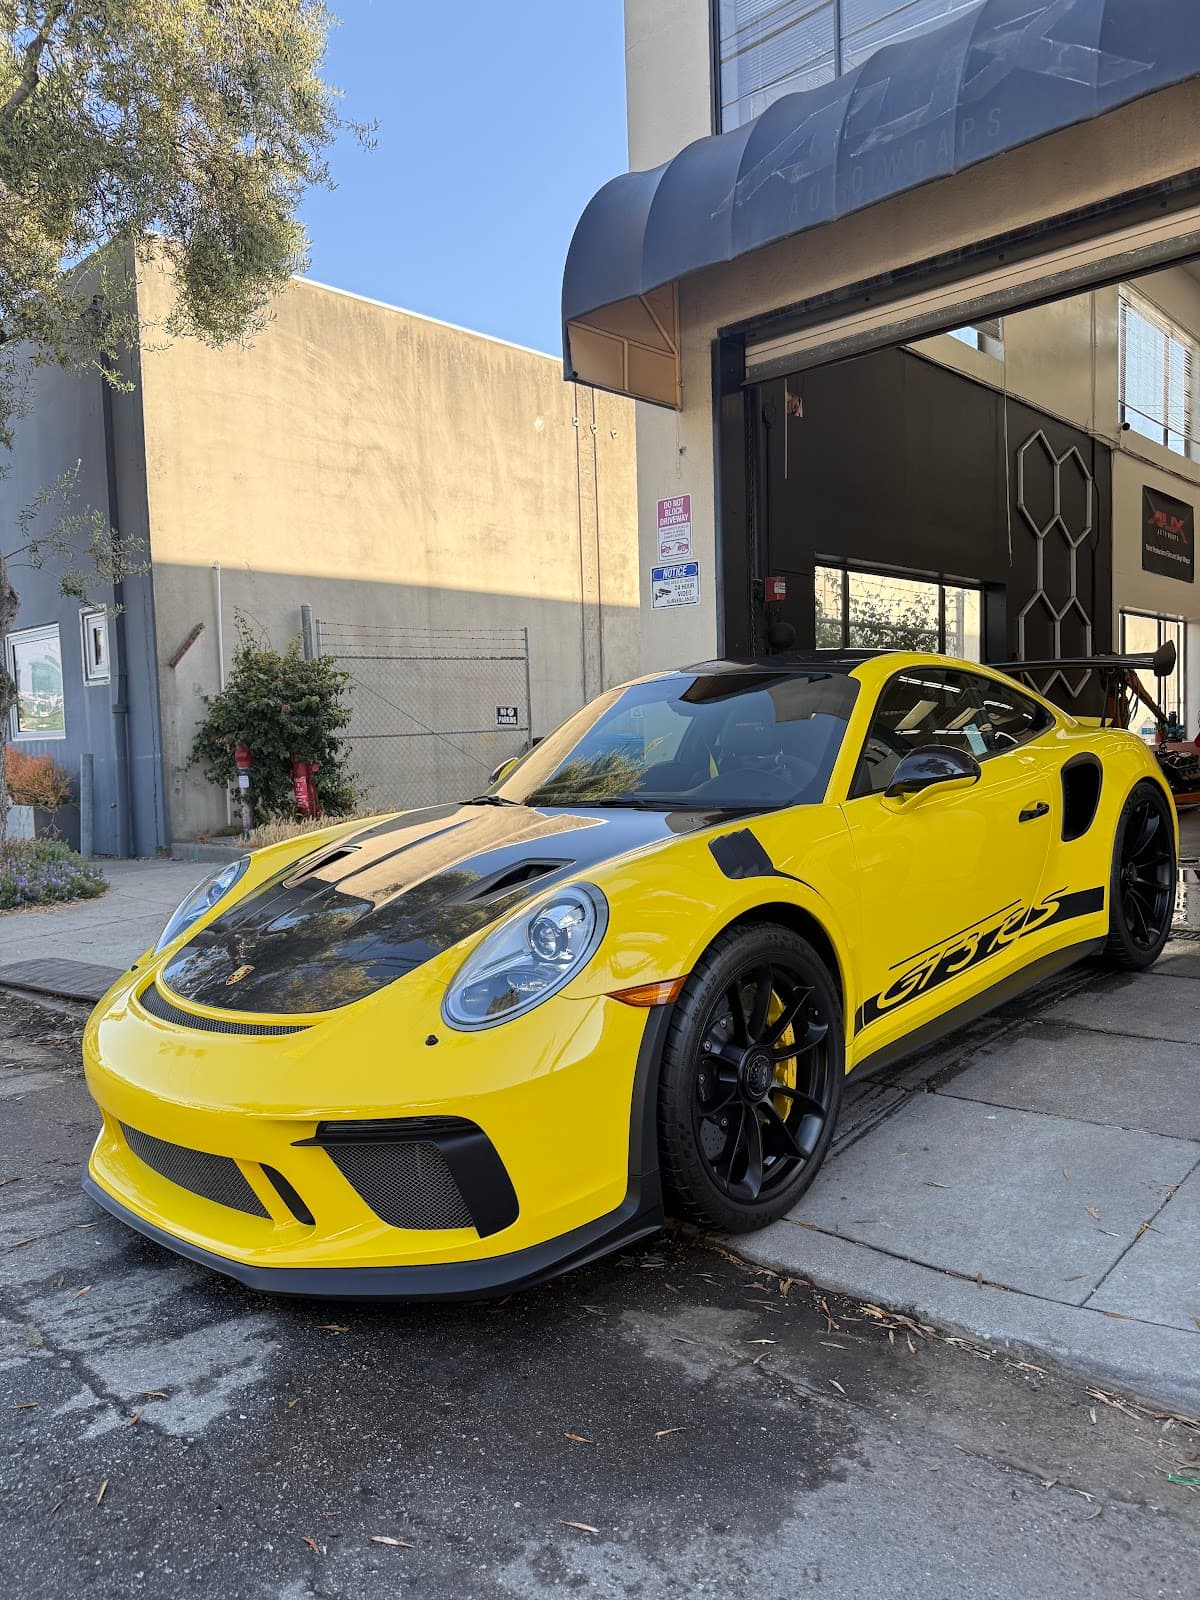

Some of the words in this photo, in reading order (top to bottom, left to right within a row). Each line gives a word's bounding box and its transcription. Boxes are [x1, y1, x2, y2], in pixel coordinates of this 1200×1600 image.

[664, 501, 672, 509] DO
[673, 498, 684, 508] NOT
[664, 506, 684, 517] BLOCK
[660, 514, 689, 526] DRIVEWAY
[662, 565, 687, 579] NOTICE
